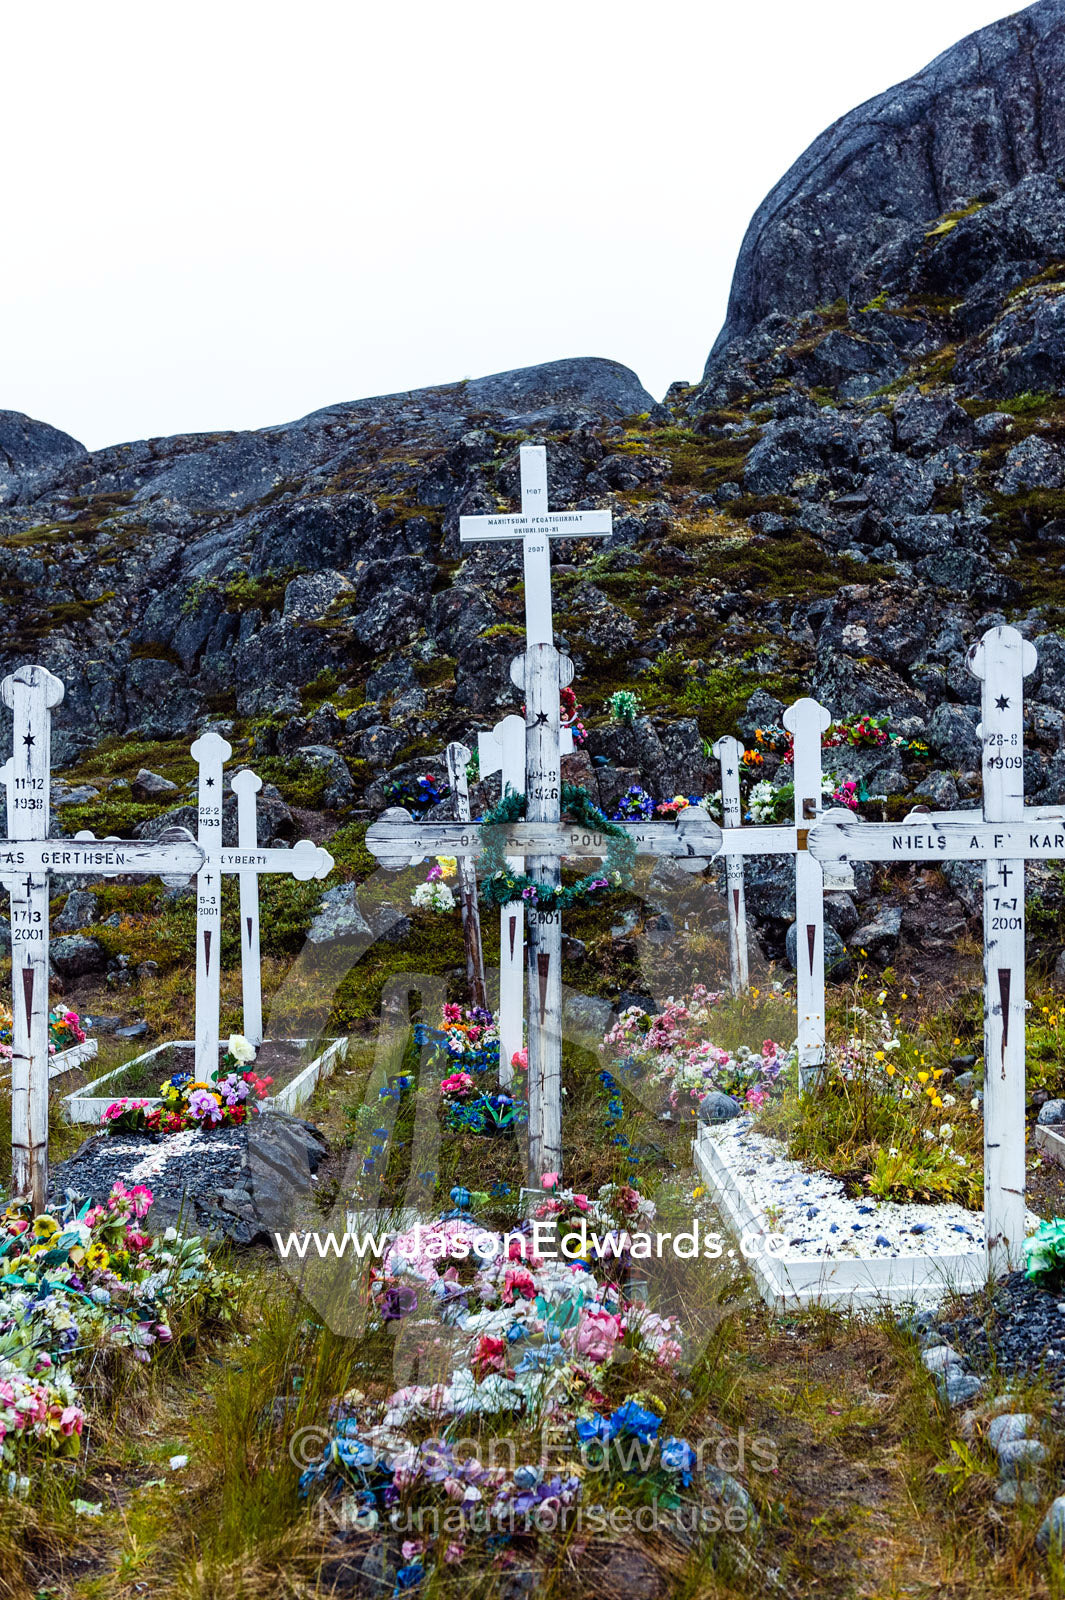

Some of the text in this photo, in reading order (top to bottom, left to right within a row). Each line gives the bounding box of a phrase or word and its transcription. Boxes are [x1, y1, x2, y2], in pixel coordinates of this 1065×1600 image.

[988, 733, 1018, 746] 28-8
[988, 757, 1023, 769] 1909
[15, 778, 44, 790] 11-12
[14, 798, 43, 810] 1938
[199, 819, 220, 827] 1933
[892, 835, 947, 849] NIELS
[1029, 834, 1065, 848] KAR
[41, 852, 125, 864] GERTHSEN
[199, 896, 216, 905] 5-3
[993, 898, 1018, 911] 7-7
[197, 907, 218, 916] 2001
[530, 912, 560, 925] 2001
[991, 917, 1022, 930] 2001
[14, 929, 44, 940] 2001
